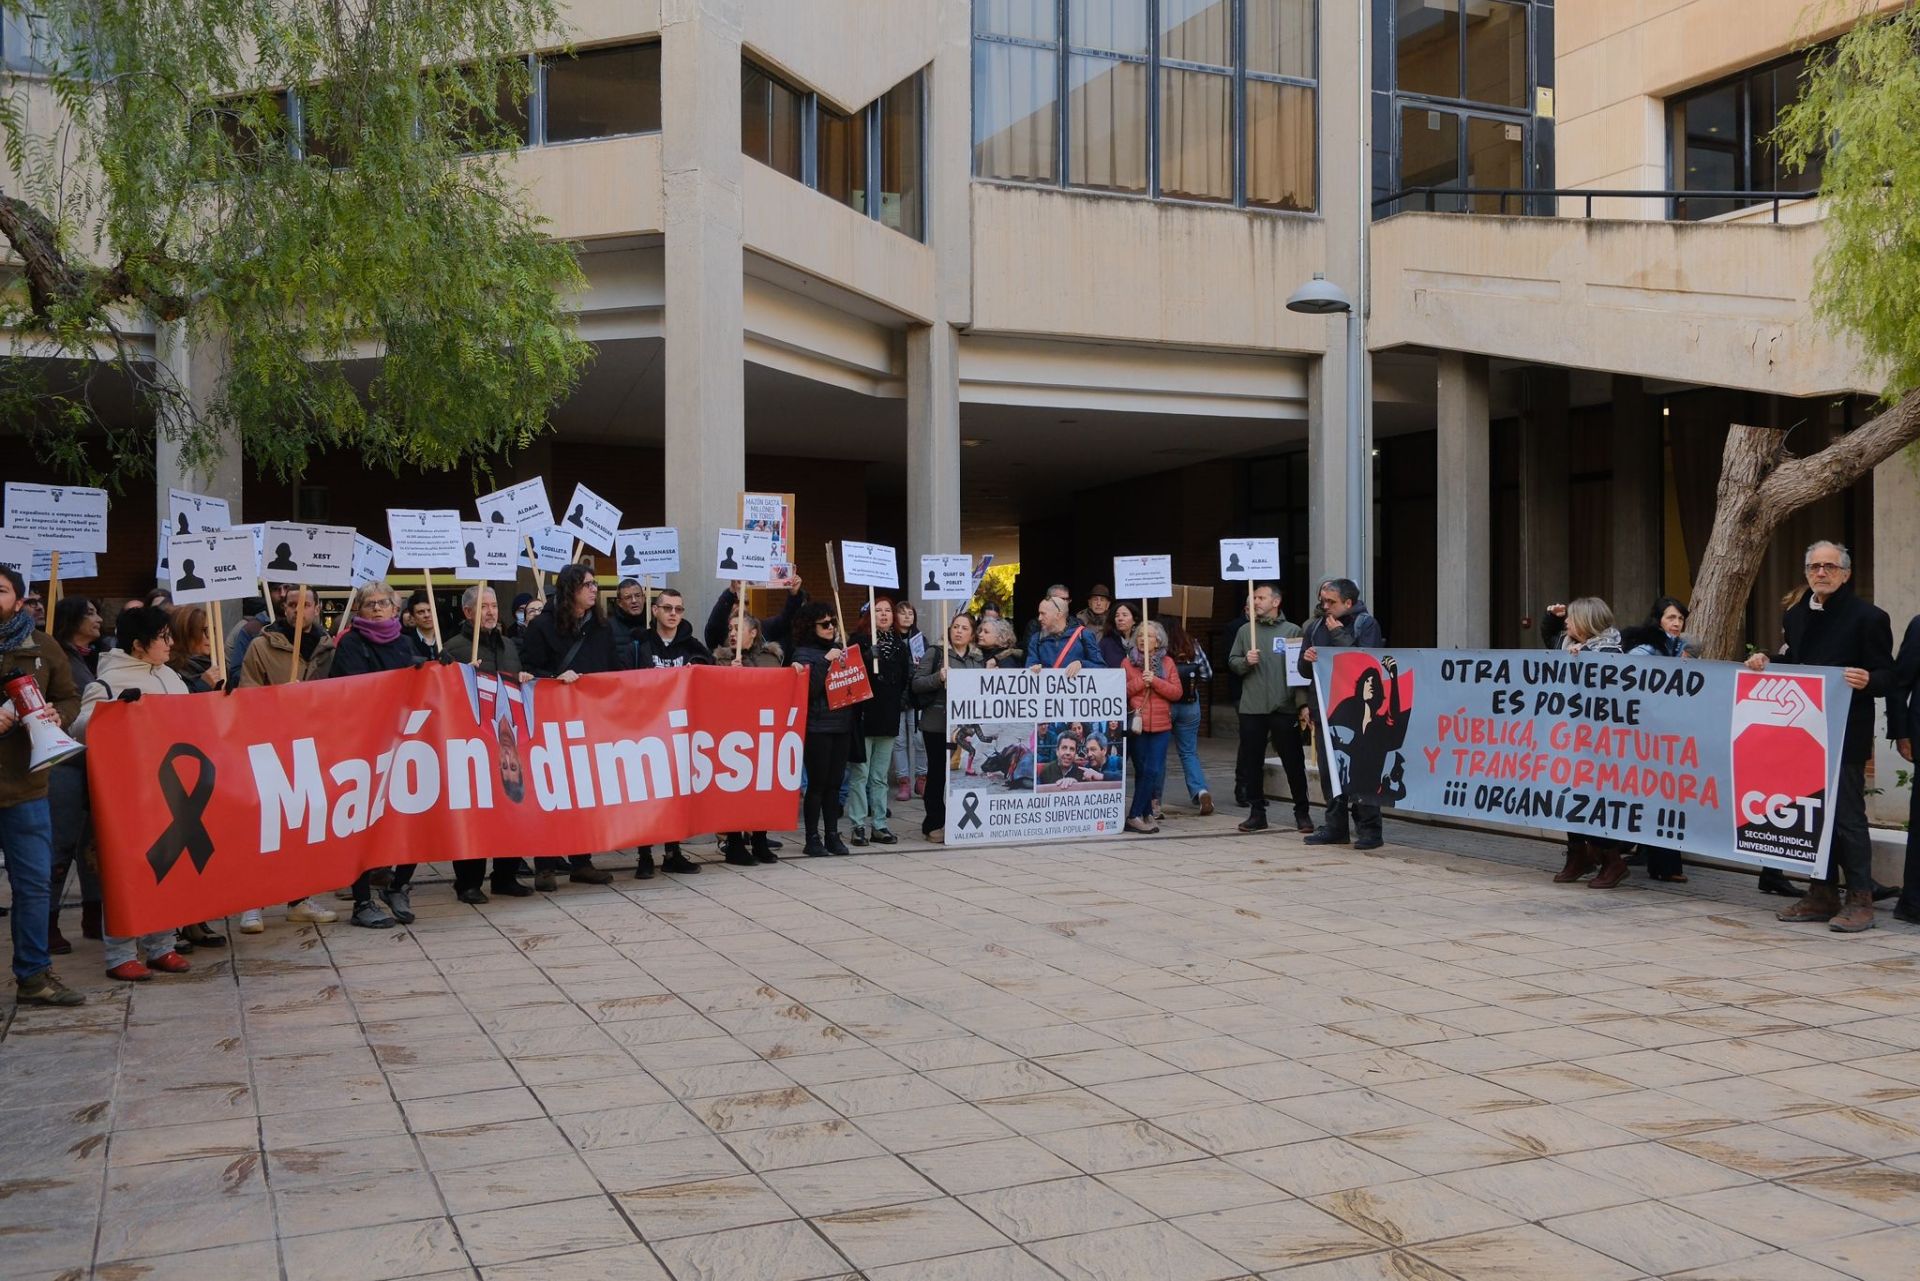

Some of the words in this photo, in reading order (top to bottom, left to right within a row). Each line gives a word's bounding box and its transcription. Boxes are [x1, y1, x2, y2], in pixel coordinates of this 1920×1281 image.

[517, 504, 539, 515] ALDAIA
[639, 548, 676, 556] MASSANASSA
[214, 564, 237, 573] SUECA
[828, 672, 865, 691] dimissió
[831, 665, 859, 680] Mazón
[980, 670, 1040, 695] MAZÓN
[1046, 675, 1097, 694] GASTA
[1441, 658, 1511, 685] OTRA
[1522, 659, 1705, 697] UNIVERSIDAD
[951, 699, 1038, 720] MILLONES
[1044, 698, 1064, 718] EN
[1070, 697, 1123, 717] TOROS
[1492, 690, 1525, 715] ES
[1534, 691, 1641, 725] POSIBLE
[1437, 707, 1538, 751] PÚBLICA,
[1550, 721, 1699, 769] GRATUITA
[247, 709, 494, 853] Mazón
[529, 707, 804, 812] dimissió
[1423, 746, 1441, 774] Y
[1452, 748, 1720, 810] TRANSFORMADORA
[989, 799, 1024, 812] FIRMA
[1026, 794, 1051, 809] AQUÍ
[1053, 795, 1081, 808] PARA
[1084, 793, 1123, 806] ACABAR
[1474, 785, 1644, 833] ORGANÍZATE
[1741, 790, 1822, 833] CGT
[989, 813, 1011, 826] CON
[1014, 811, 1042, 825] ESAS
[1044, 807, 1119, 823] SUBVENCIONES
[989, 828, 1022, 839] INICIATIVA
[1023, 826, 1062, 837] LEGISLATIVA
[1063, 824, 1091, 834] POPULAR
[1744, 829, 1778, 843] SECCIÓN
[1778, 834, 1814, 848] SINDICAL
[1738, 840, 1785, 855] UNIVERSIDAD
[1785, 847, 1817, 860] ALICANT
